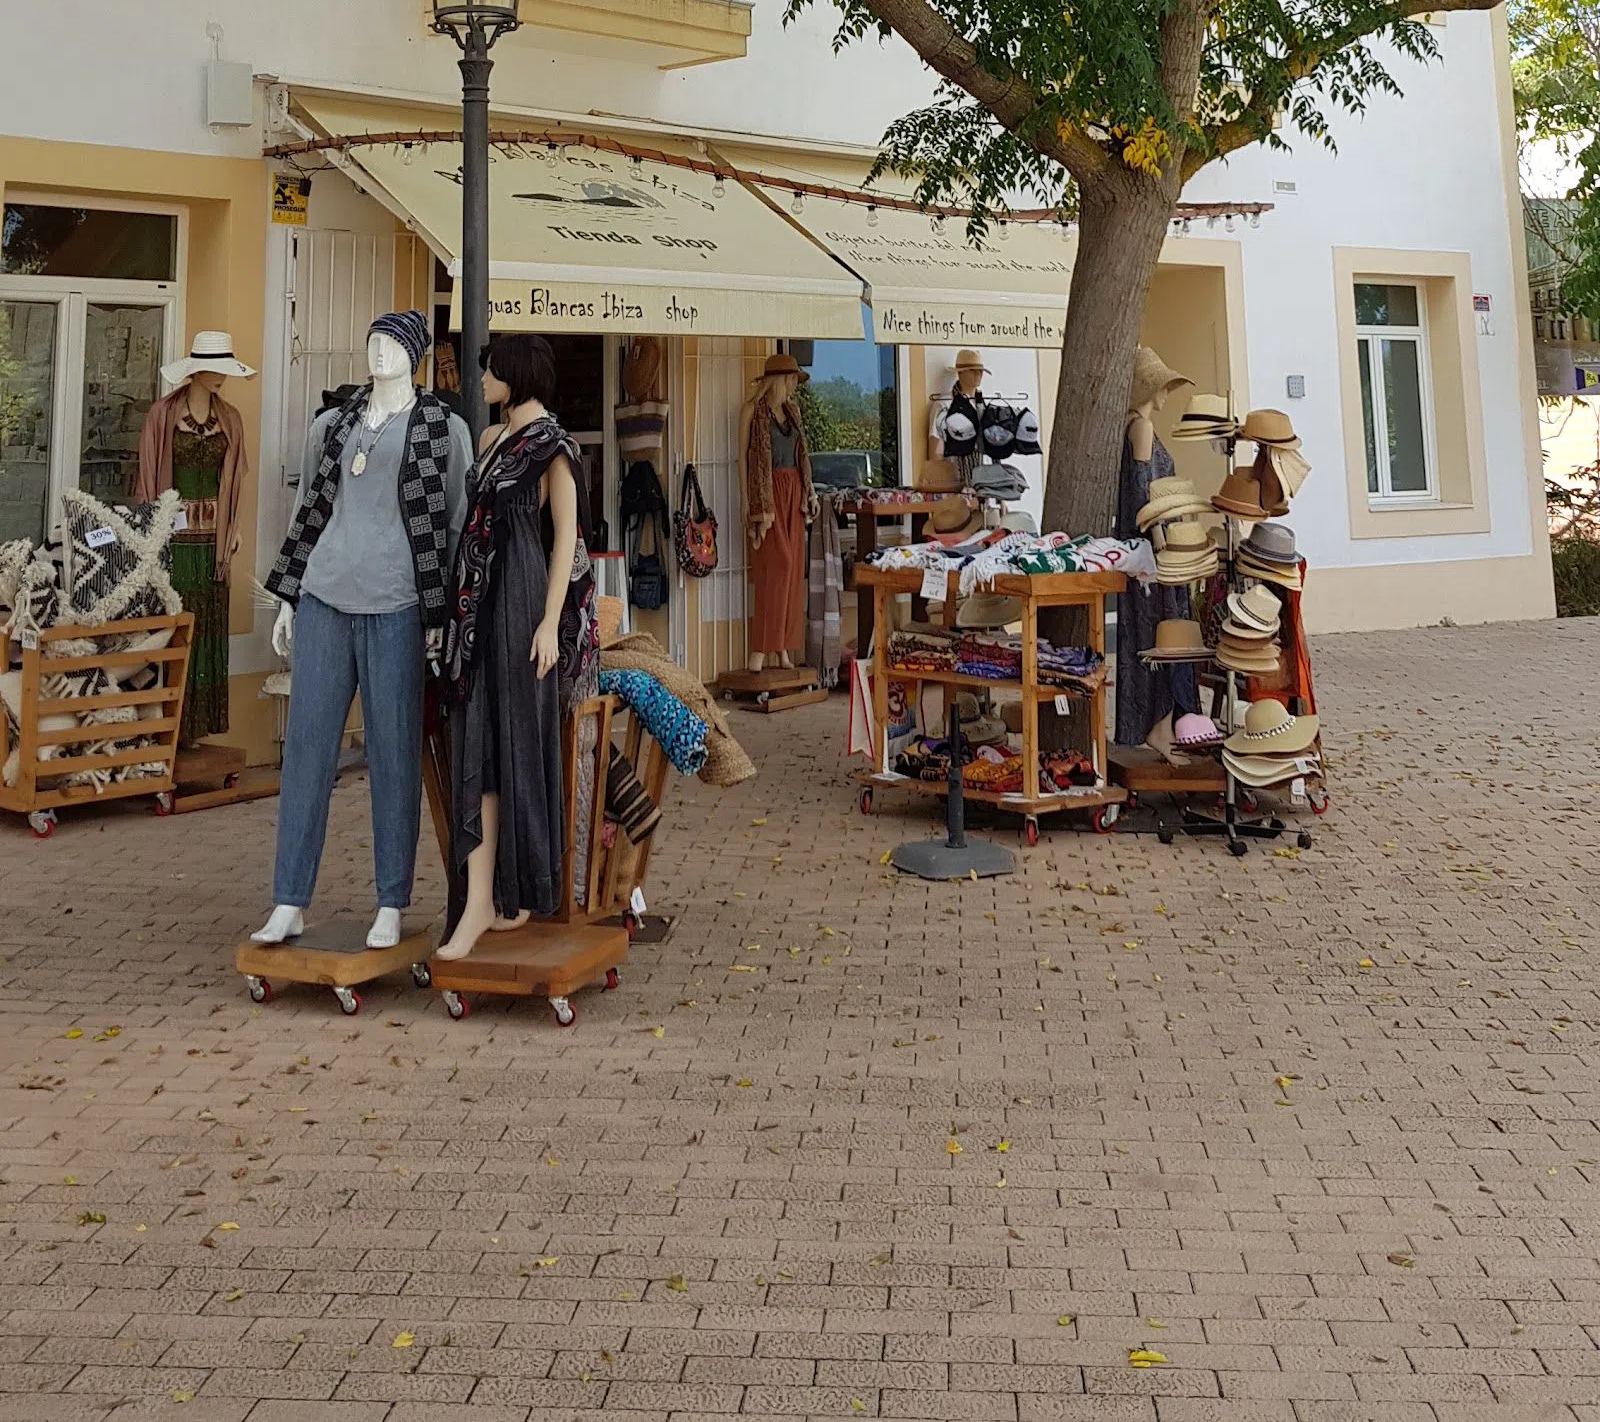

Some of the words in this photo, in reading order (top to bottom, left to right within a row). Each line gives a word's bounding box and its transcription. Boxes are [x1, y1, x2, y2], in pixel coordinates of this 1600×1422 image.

[490, 142, 614, 173] Blacas
[547, 226, 642, 245] Tienda
[652, 234, 718, 252] Shop
[934, 239, 954, 251] del
[960, 243, 1001, 253] mdo
[848, 250, 884, 264] Nice
[888, 253, 930, 269] things
[928, 256, 961, 268] from
[966, 259, 1010, 271] around
[1011, 260, 1034, 273] the
[1039, 261, 1071, 273] world
[488, 300, 521, 321] guas
[530, 288, 594, 316] Blancas
[601, 291, 643, 319] Ibiza
[666, 295, 698, 328] shop
[883, 308, 912, 333] Nice
[918, 311, 955, 339] things
[959, 312, 986, 338] from
[991, 316, 1028, 338] around
[1034, 316, 1053, 338] the
[90, 528, 112, 541] 30%
